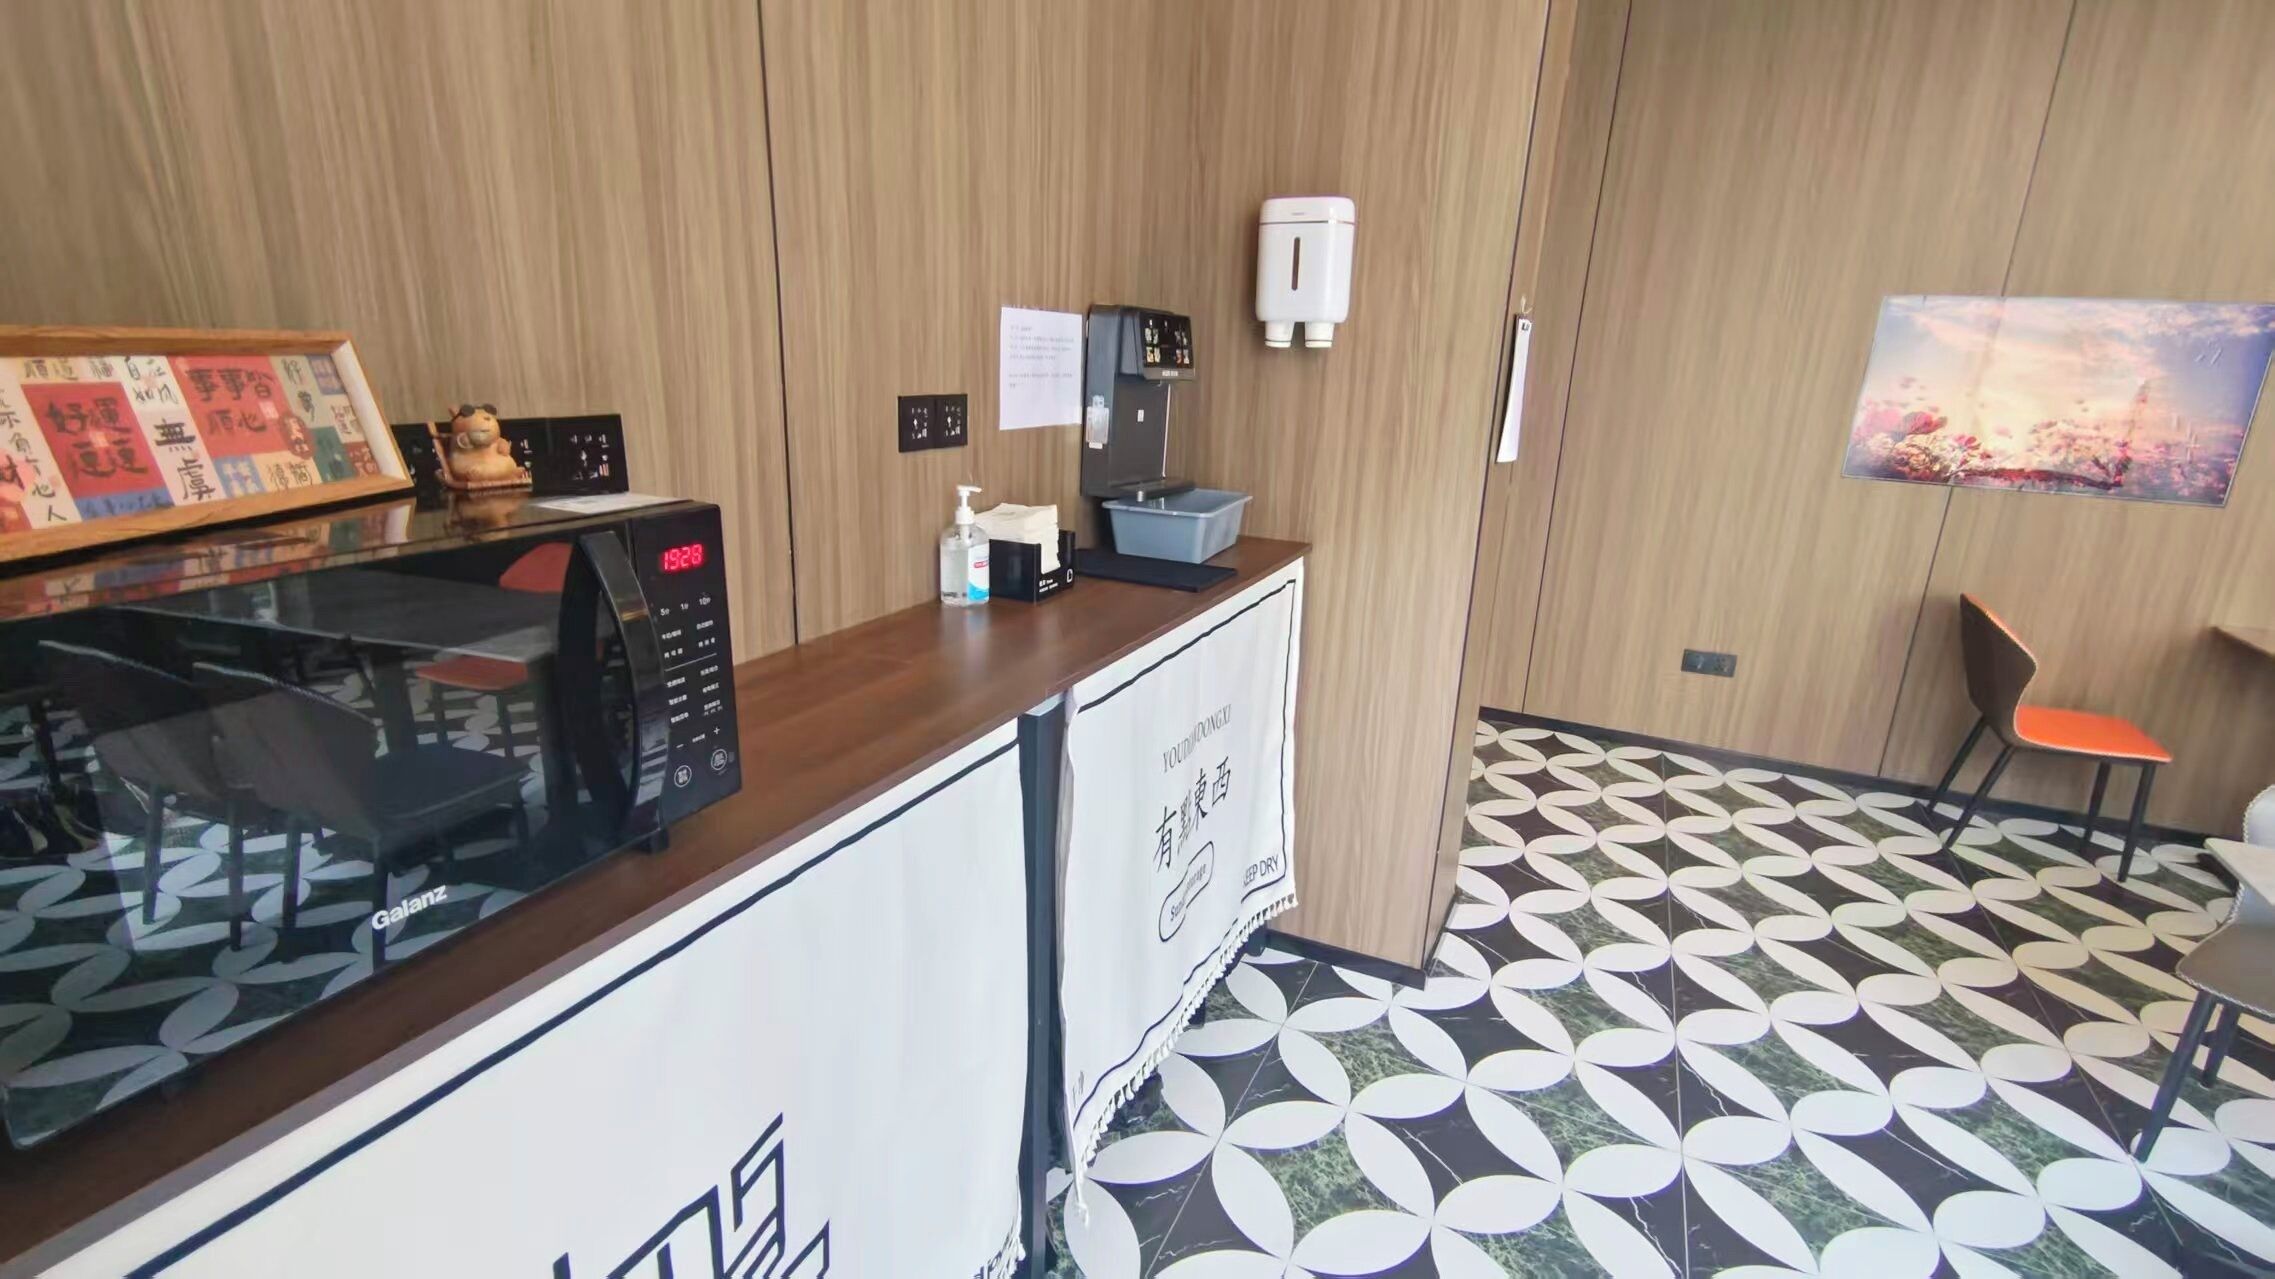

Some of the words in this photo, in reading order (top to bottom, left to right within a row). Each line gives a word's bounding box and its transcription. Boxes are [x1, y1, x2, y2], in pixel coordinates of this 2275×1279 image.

[663, 543, 703, 571] 1928
[1153, 755, 1231, 873] 有點東西
[1243, 863, 1258, 887] EEP
[1259, 854, 1279, 877] DRY
[371, 884, 448, 931] Galanz
